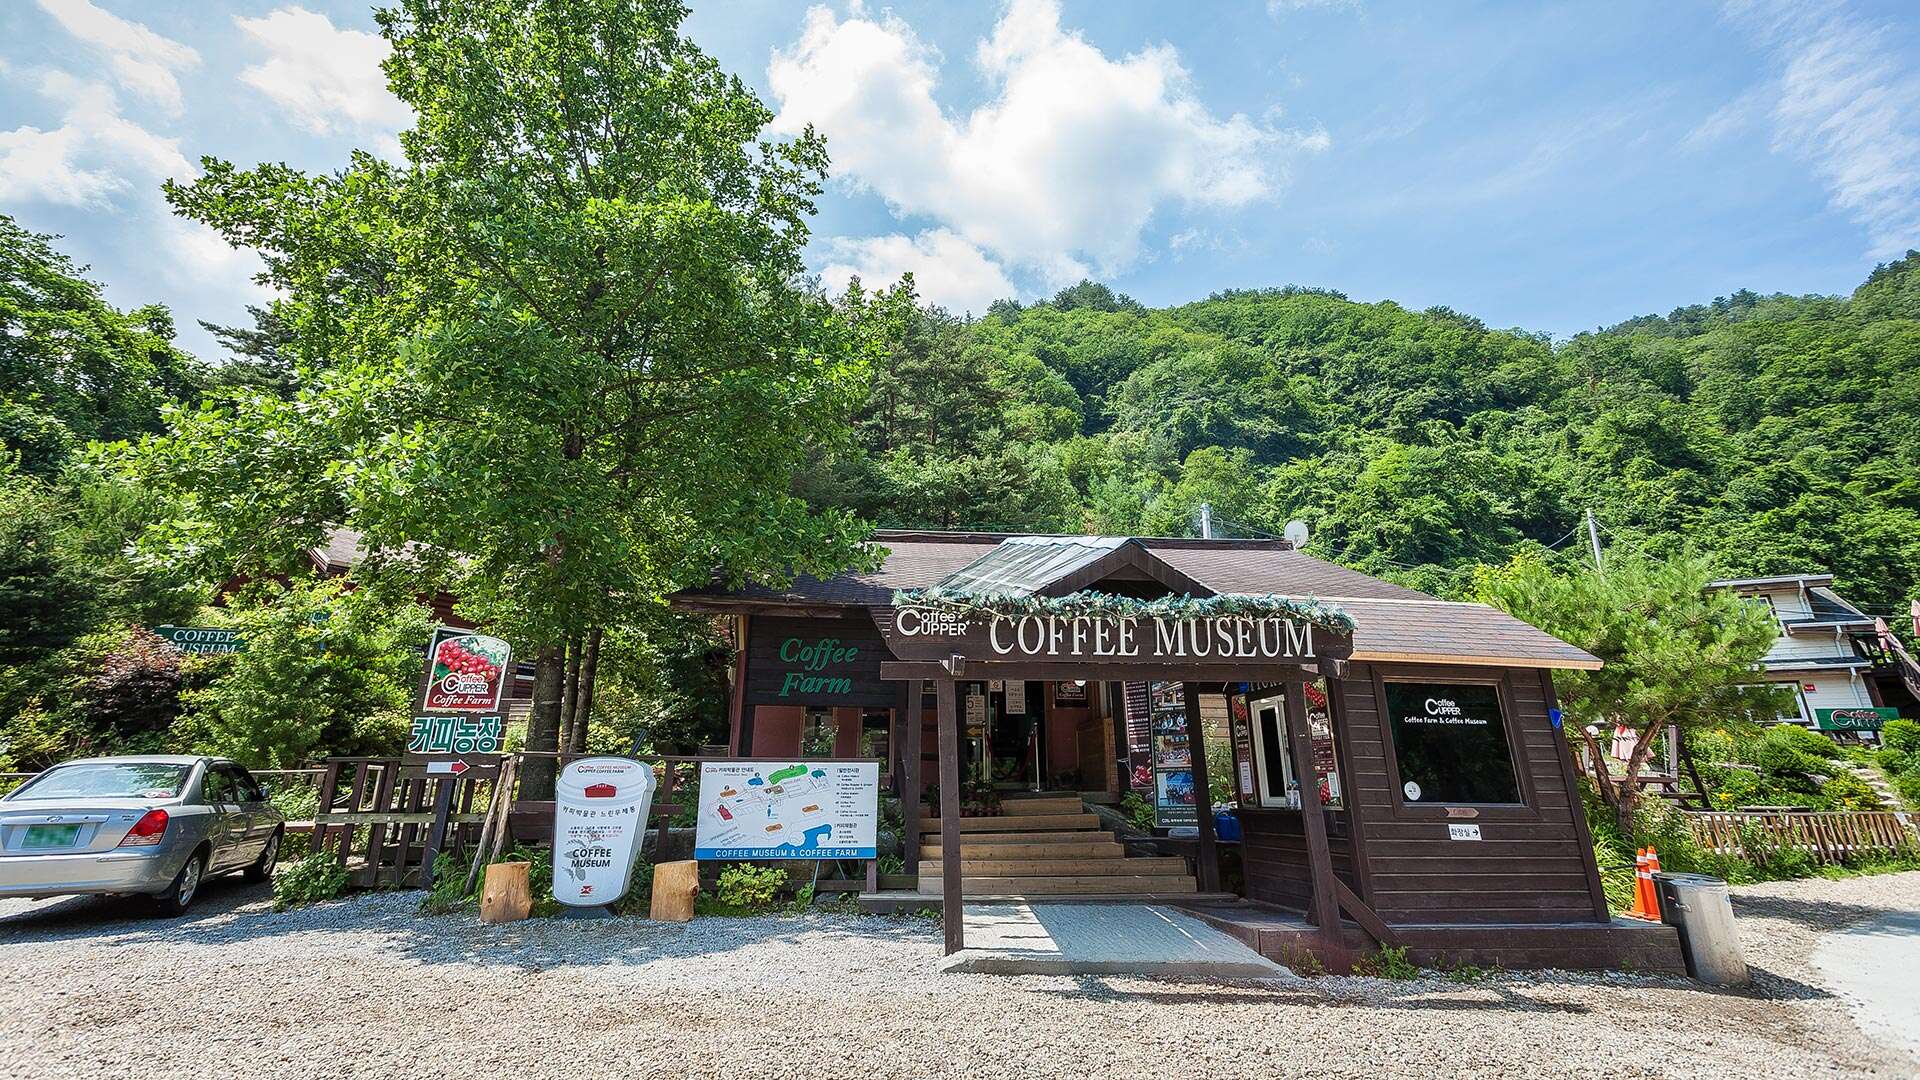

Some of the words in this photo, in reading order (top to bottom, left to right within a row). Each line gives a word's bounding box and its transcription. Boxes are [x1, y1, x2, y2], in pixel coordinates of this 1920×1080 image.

[173, 630, 236, 642] COFFEE
[990, 615, 1139, 655] COFFEE
[1153, 616, 1316, 658] MUSEUM
[780, 638, 859, 671] Coffee
[778, 672, 852, 697] Farm
[432, 694, 463, 707] Coffee
[465, 695, 491, 705] Farm
[408, 717, 501, 753] 커피농장
[1451, 828, 1471, 837] 화장실
[572, 849, 612, 858] COFFEE
[715, 849, 749, 857] COFFEE
[752, 849, 787, 857] MUSEUM
[790, 849, 796, 857] &
[800, 849, 832, 857] COFFEE
[835, 849, 858, 857] FARM
[571, 860, 611, 868] MUSEUM
